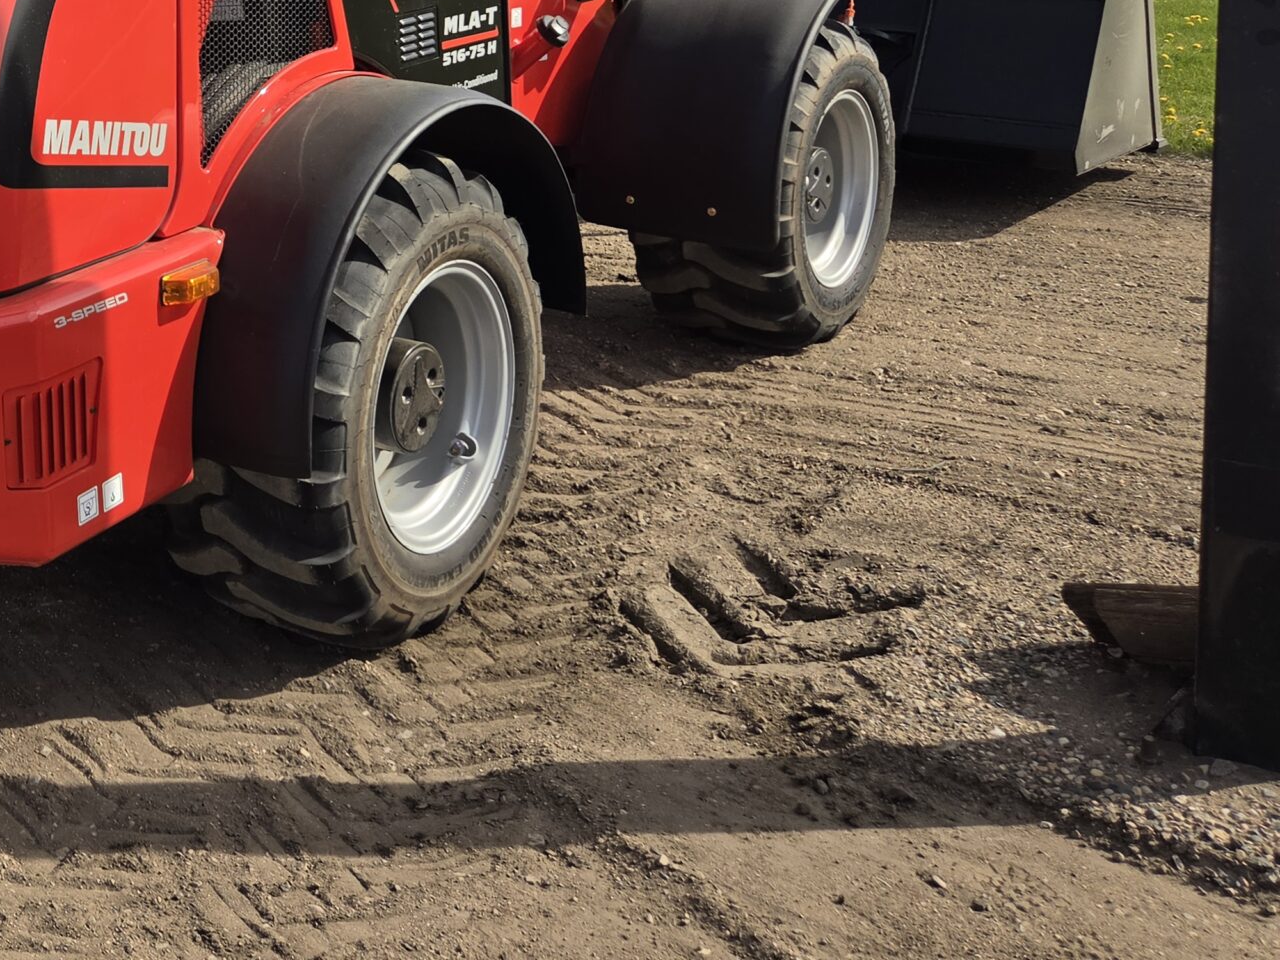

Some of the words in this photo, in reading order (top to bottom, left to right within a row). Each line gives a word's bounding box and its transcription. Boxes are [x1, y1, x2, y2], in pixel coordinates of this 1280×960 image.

[444, 6, 498, 36] MLA-T
[442, 44, 486, 67] 516-75
[487, 40, 497, 55] H
[42, 118, 168, 157] MANITOU
[415, 226, 471, 273] MITAS
[53, 292, 129, 329] 3-SPEED
